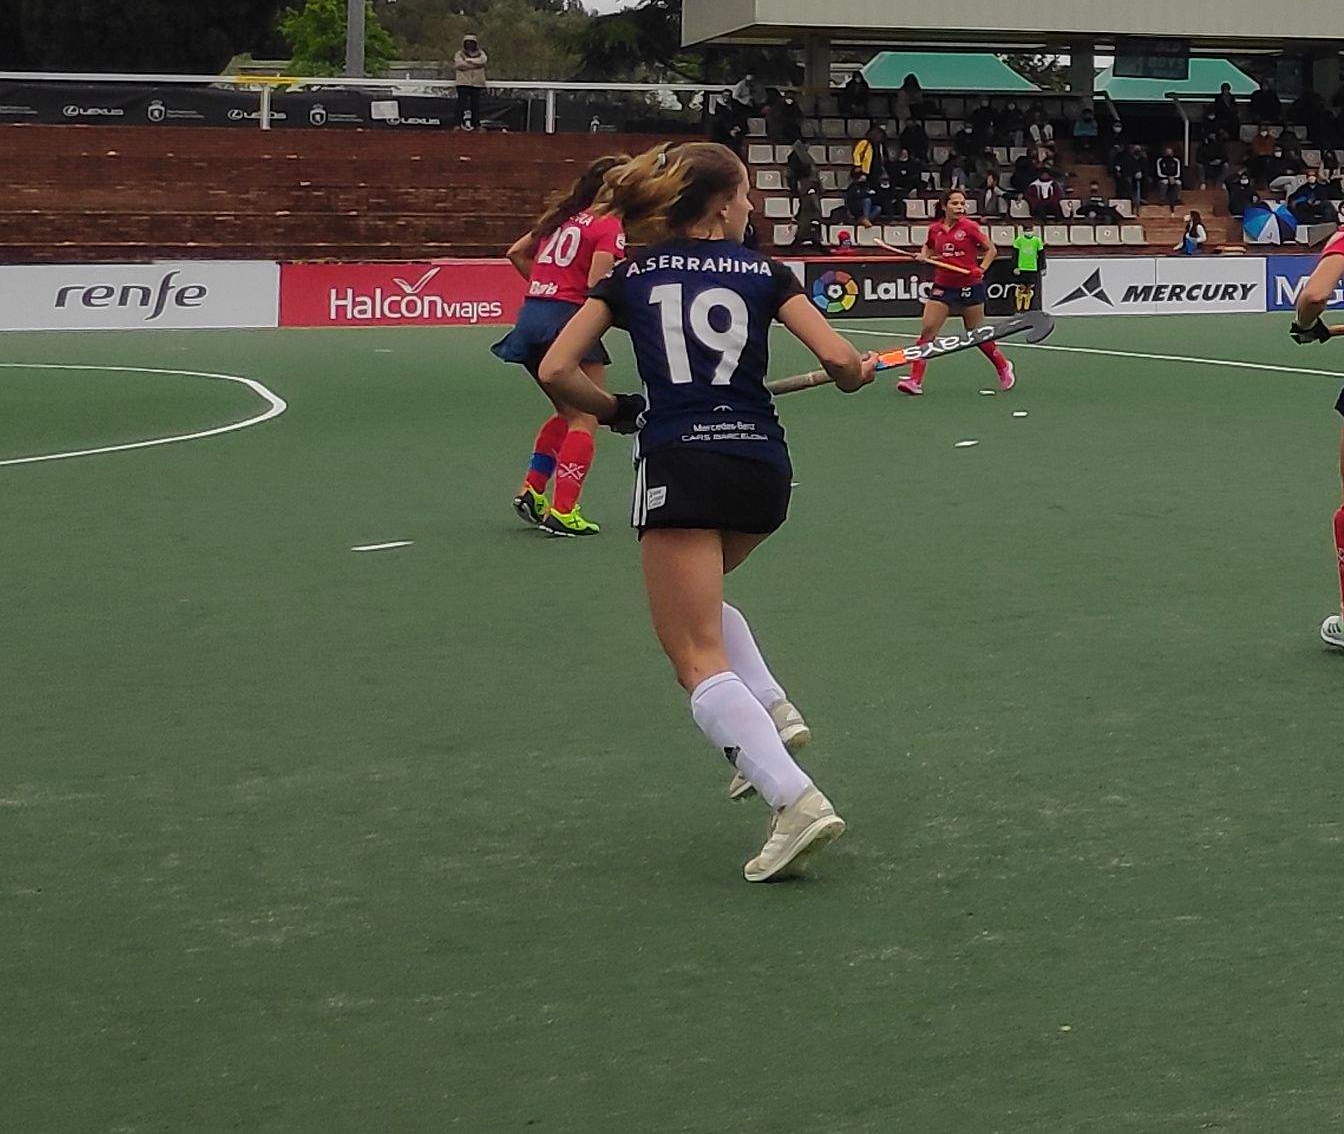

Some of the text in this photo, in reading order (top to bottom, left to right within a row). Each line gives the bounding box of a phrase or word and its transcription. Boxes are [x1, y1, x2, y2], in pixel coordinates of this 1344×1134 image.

[537, 226, 581, 268] 20
[625, 255, 773, 278] A.SERRAHIMA
[54, 270, 208, 321] renfe
[863, 278, 934, 304] LaLig
[1119, 283, 1259, 303] MERCURY
[648, 282, 749, 386] 19
